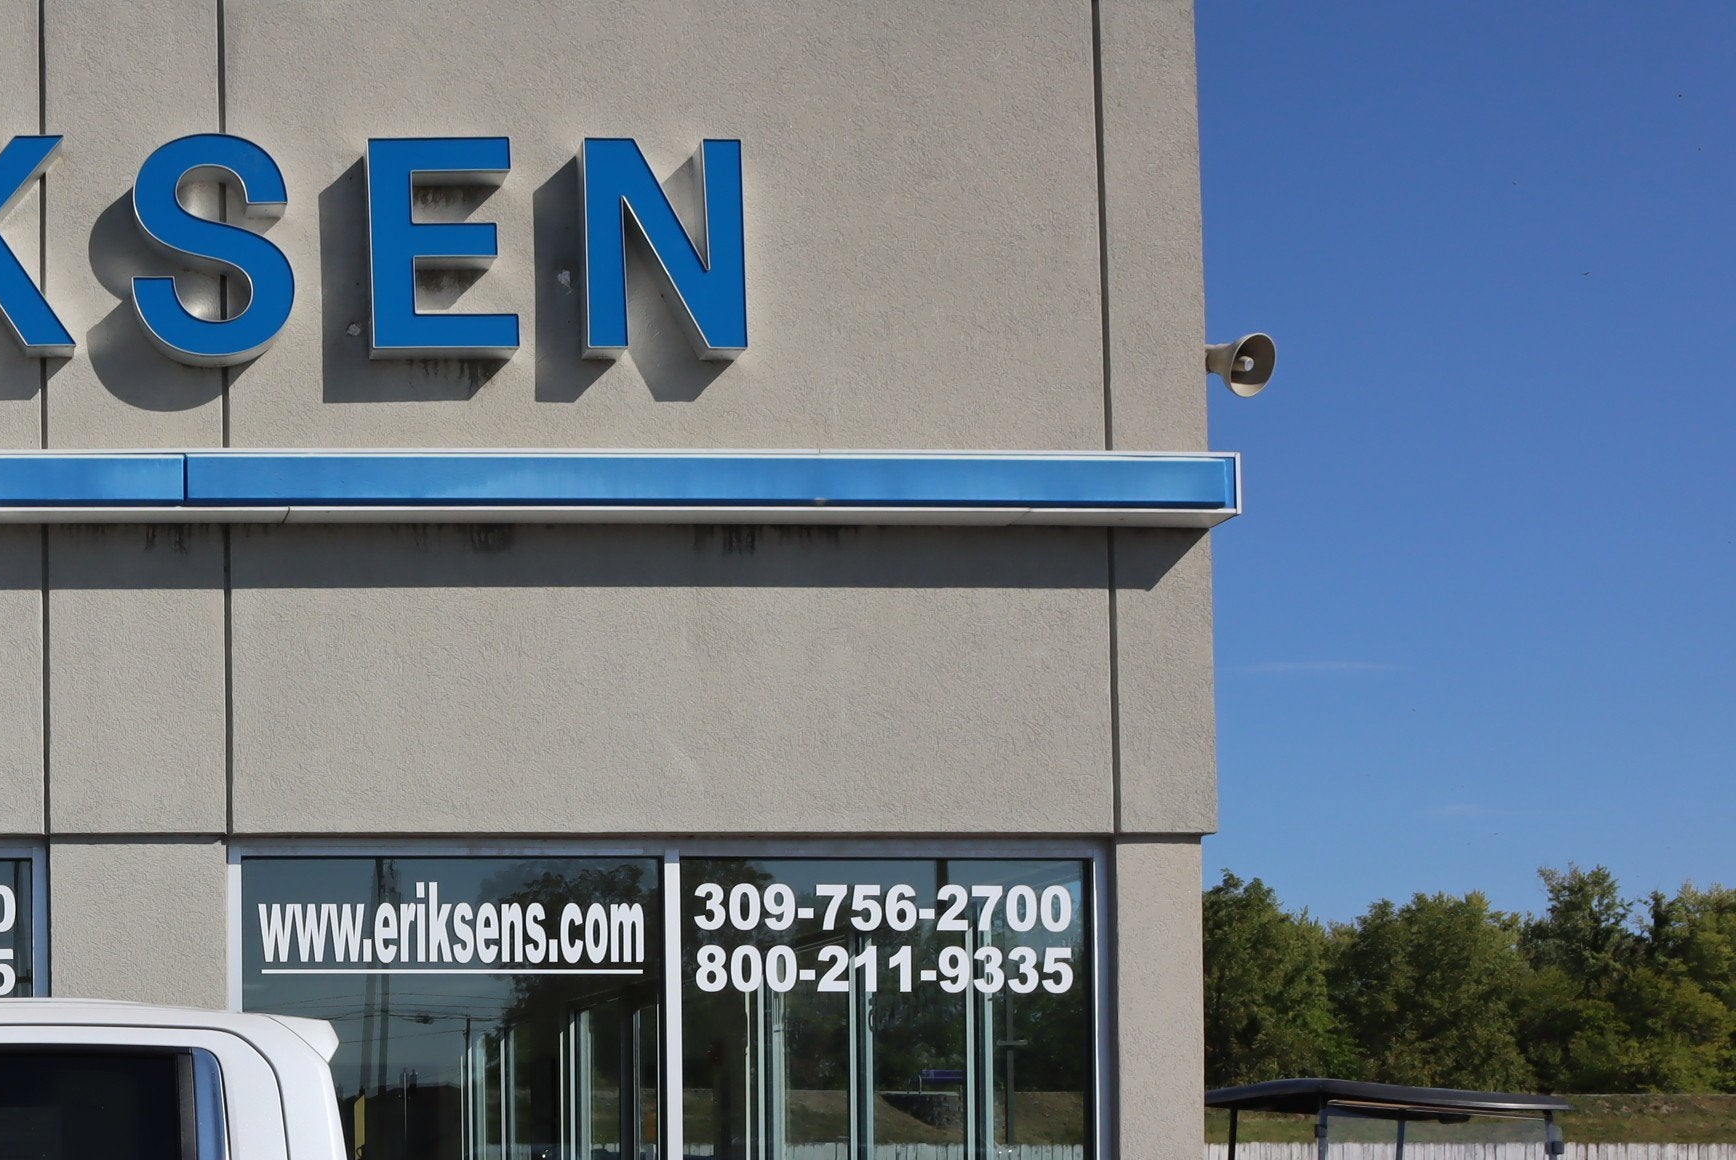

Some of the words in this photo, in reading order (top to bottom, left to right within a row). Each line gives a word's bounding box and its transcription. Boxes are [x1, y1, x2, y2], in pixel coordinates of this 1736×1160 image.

[257, 881, 645, 964] www.eriksens.com
[693, 882, 1072, 933] 309-756-2700
[695, 944, 1074, 994] 800-211-9335
